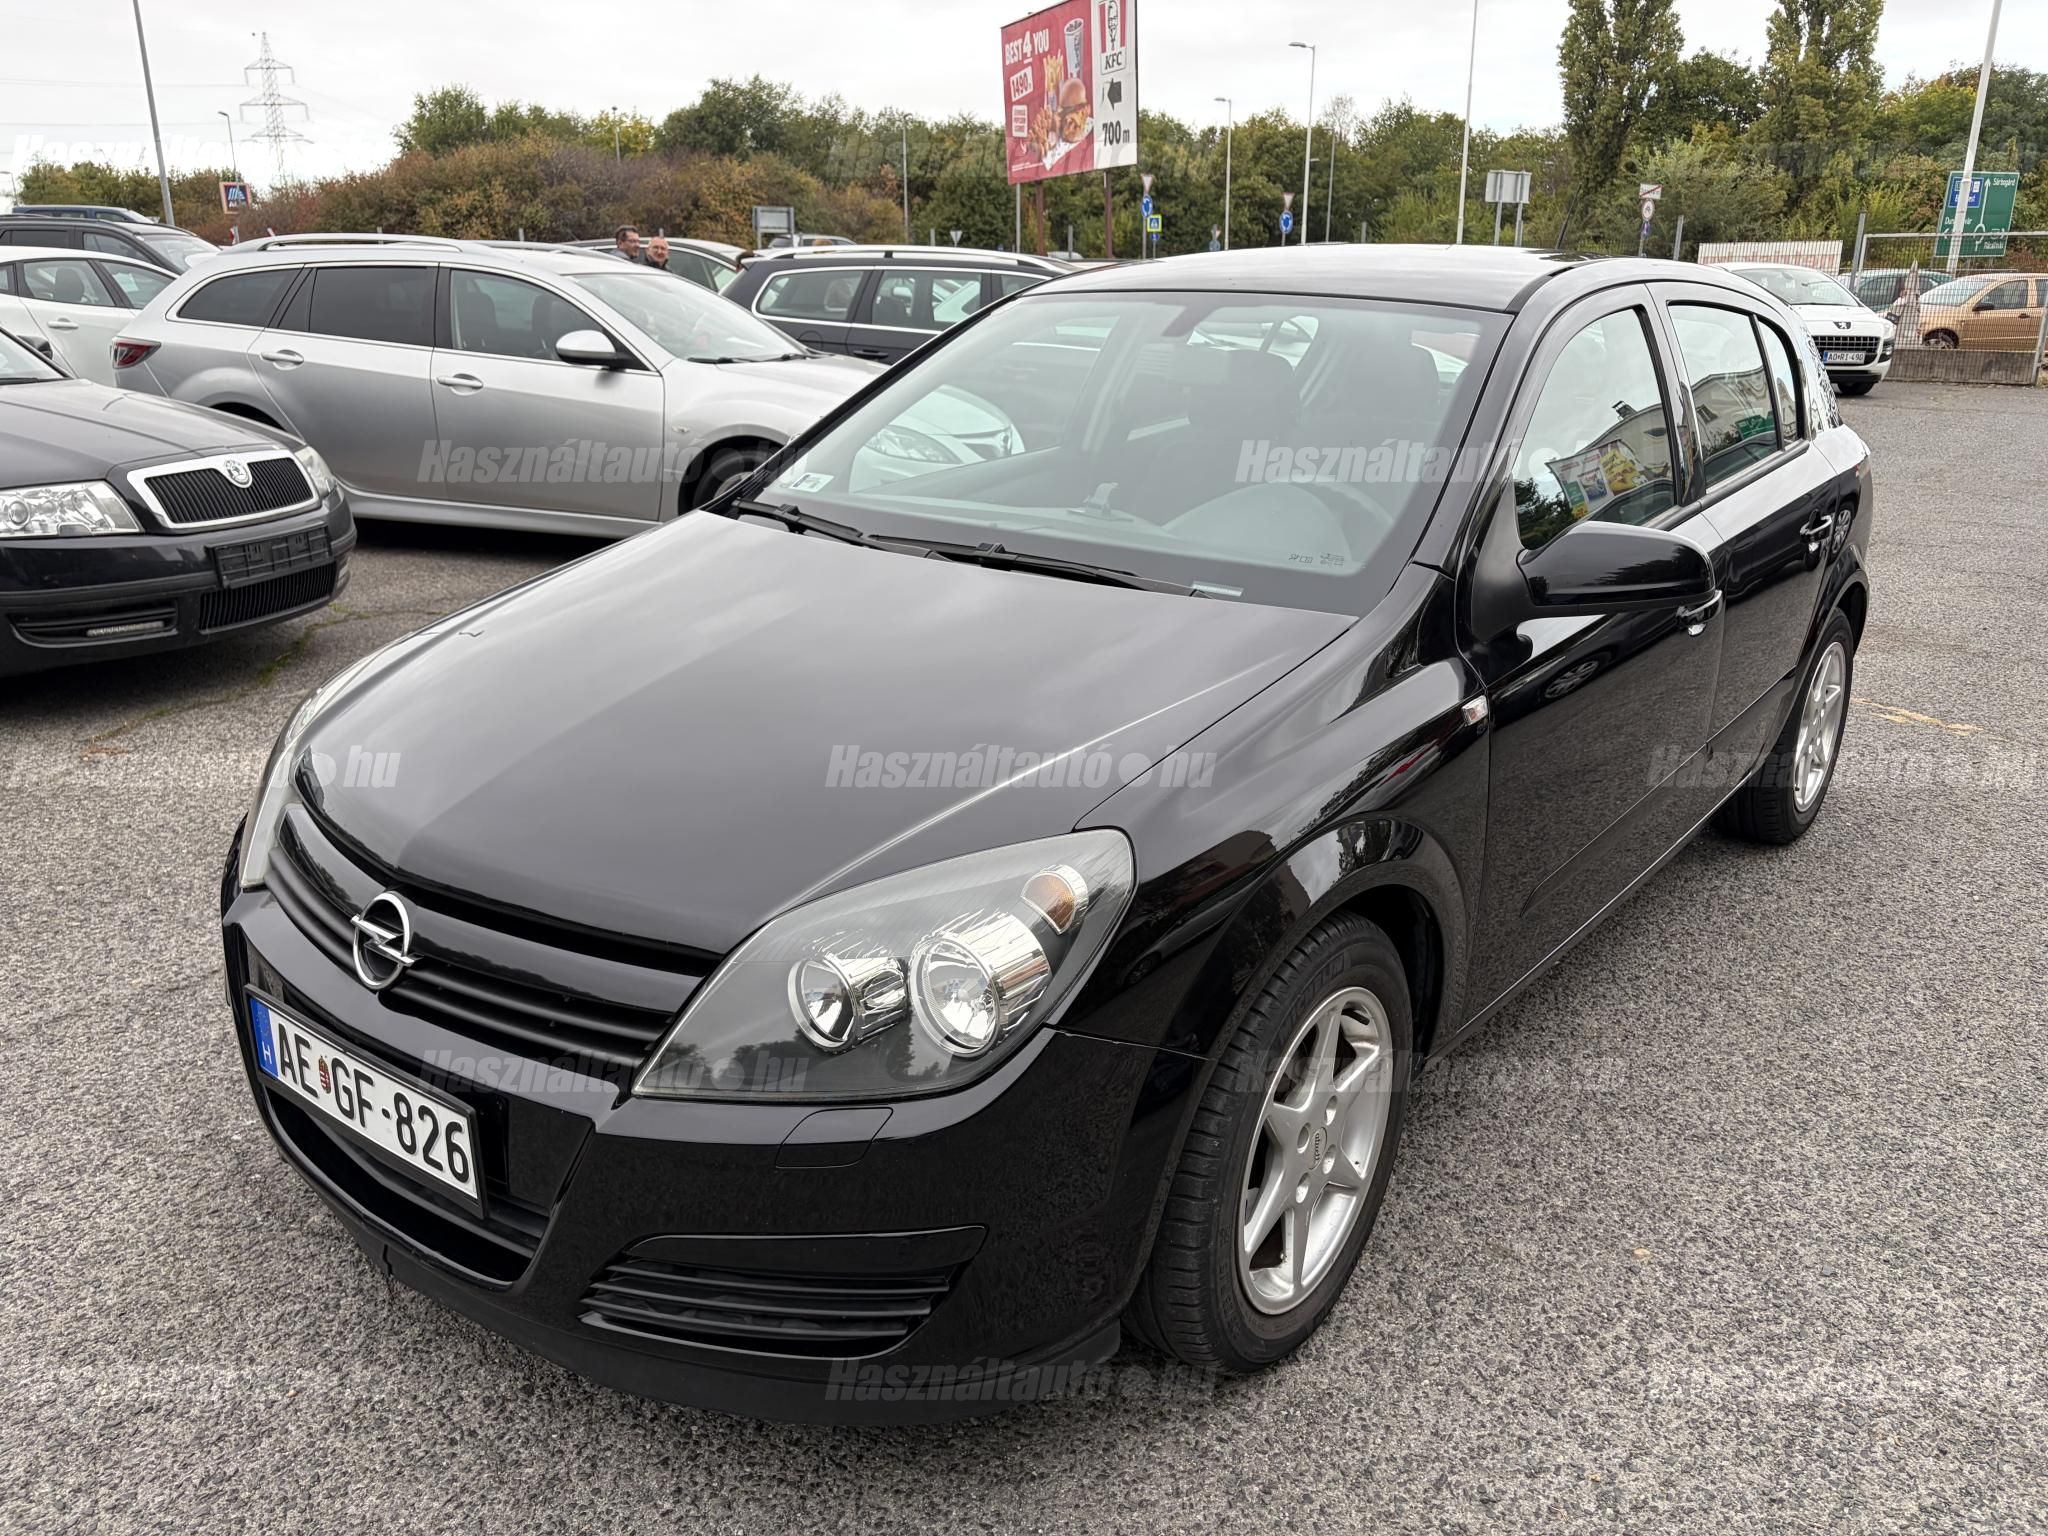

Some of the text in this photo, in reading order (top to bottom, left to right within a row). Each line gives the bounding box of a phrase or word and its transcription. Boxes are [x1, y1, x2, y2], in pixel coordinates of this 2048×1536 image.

[1005, 38, 1023, 65] BEST
[1023, 30, 1032, 58] 4
[1033, 28, 1049, 55] YOU
[1104, 51, 1122, 70] KFC
[1102, 120, 1130, 147] 700 m
[262, 1042, 273, 1064] H
[278, 1023, 470, 1184] AE GF-826
